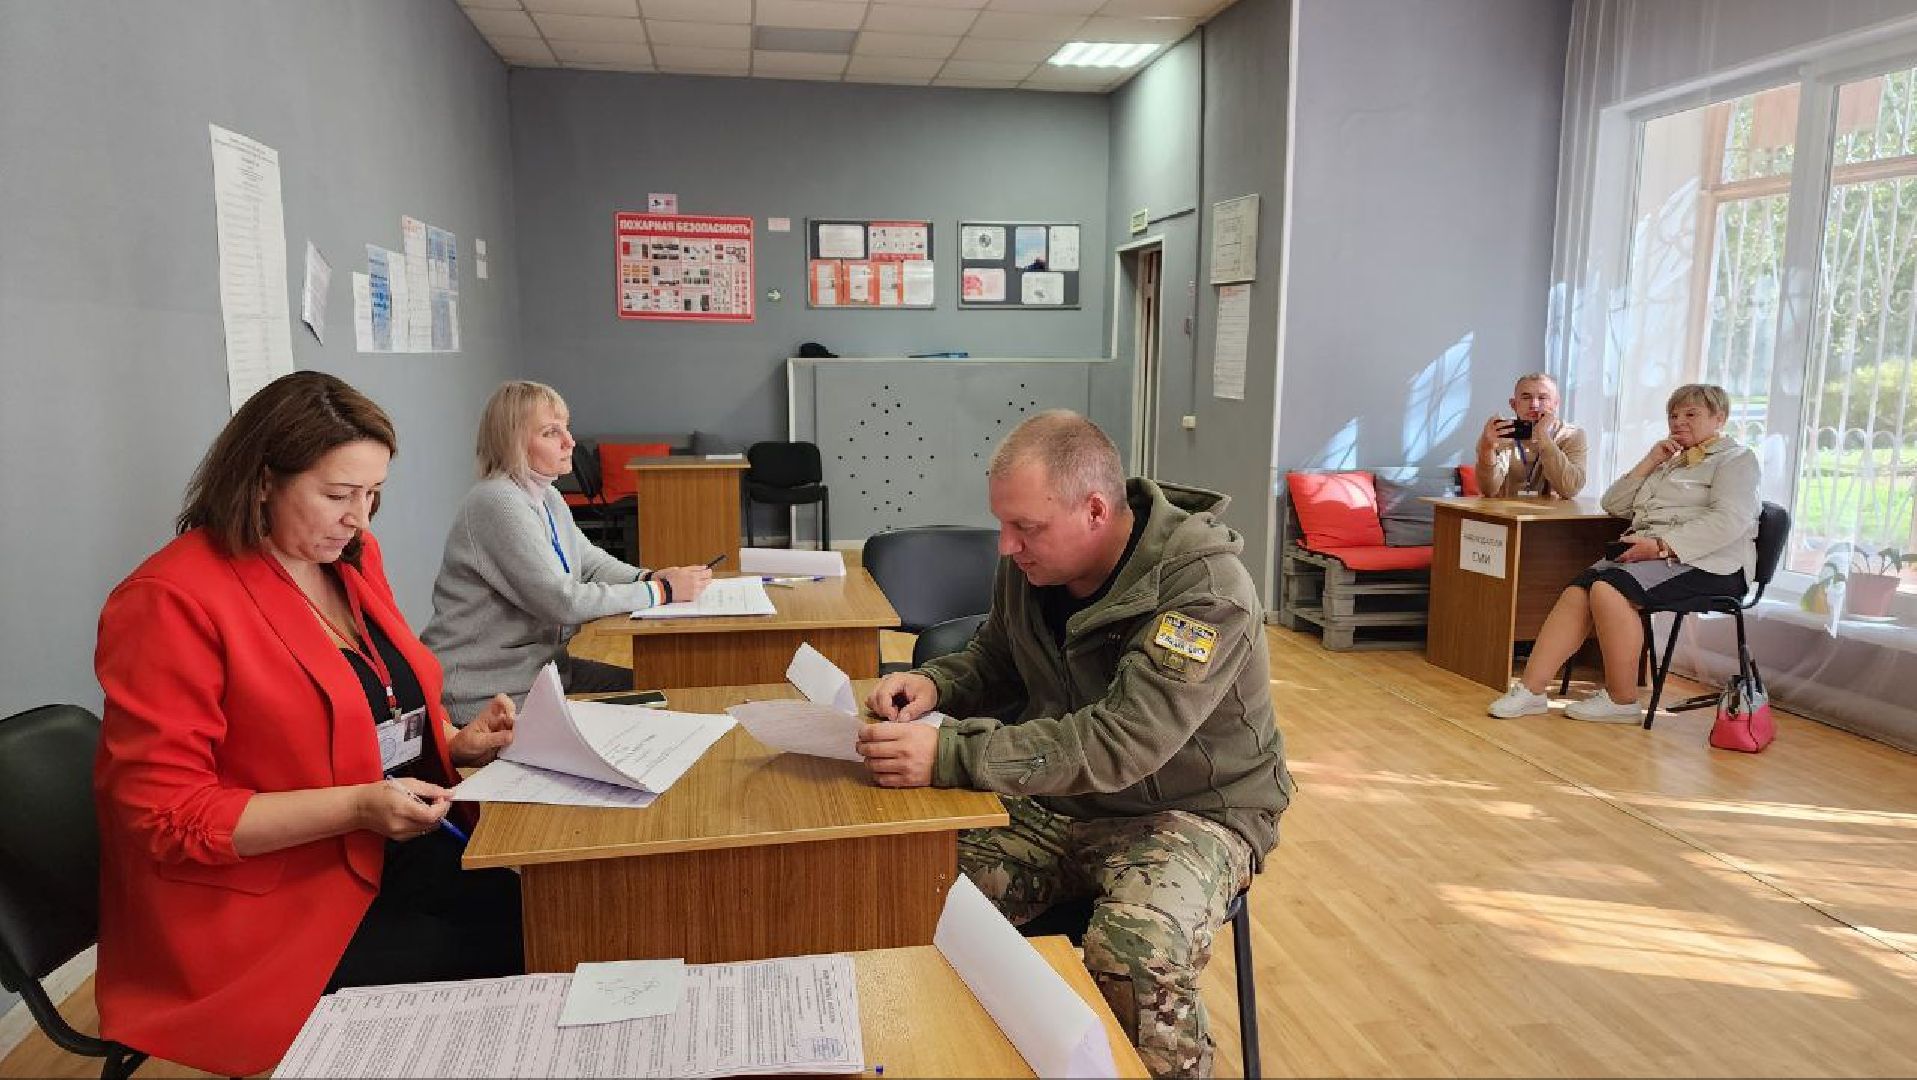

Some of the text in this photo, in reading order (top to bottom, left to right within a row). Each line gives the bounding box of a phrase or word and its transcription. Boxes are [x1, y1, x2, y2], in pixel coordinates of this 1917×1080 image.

[619, 219, 750, 234] ПОЖАРНАЯ БЕЗОПАСНОСТЬ
[1472, 551, 1491, 564] СМИ
